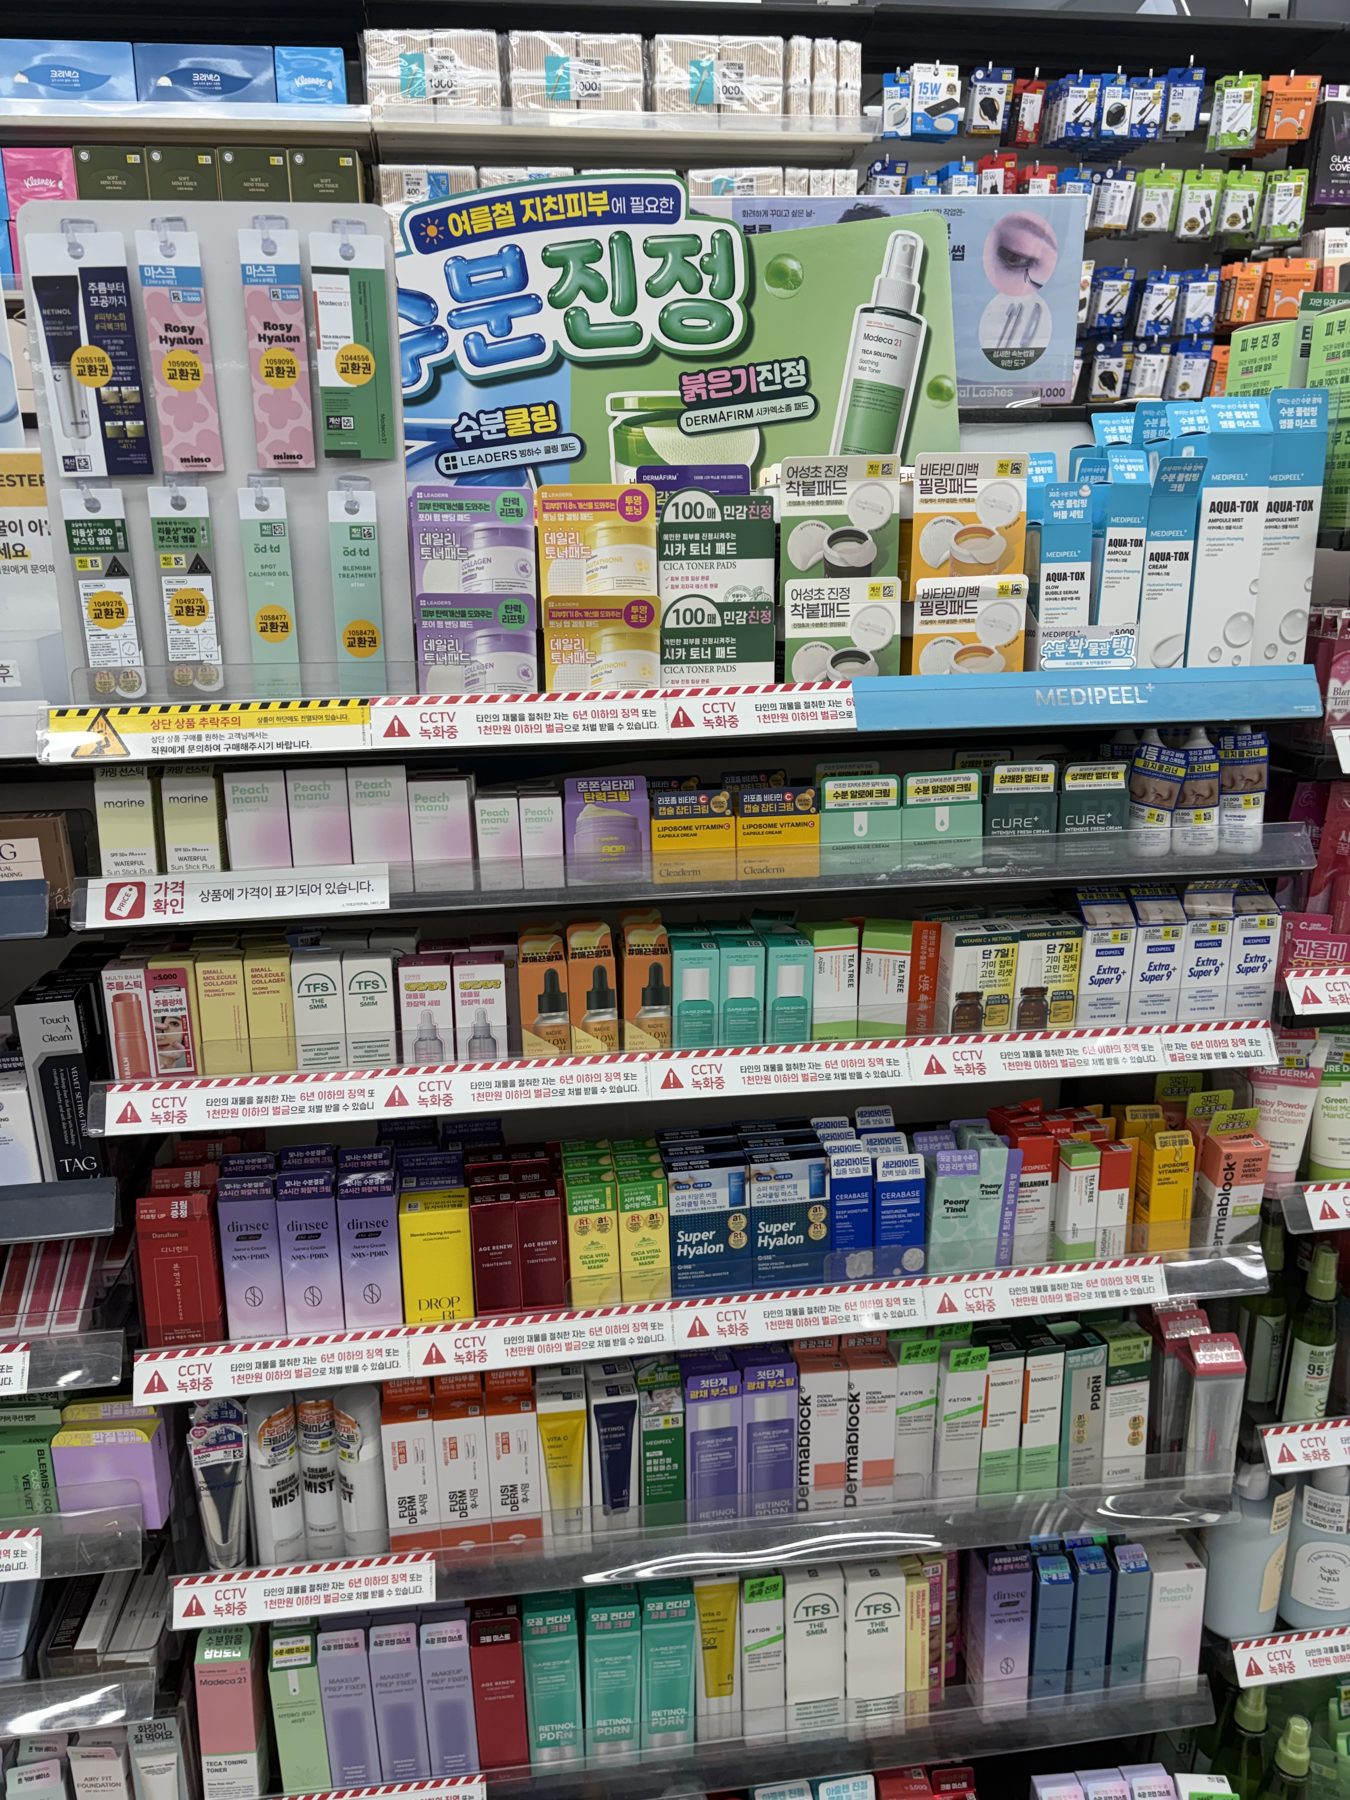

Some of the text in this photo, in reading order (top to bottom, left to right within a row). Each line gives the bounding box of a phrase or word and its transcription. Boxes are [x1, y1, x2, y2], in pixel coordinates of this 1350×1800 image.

[50, 70, 79, 78] 크리넥스
[918, 82, 941, 95] 15W
[447, 199, 515, 238] 여름철
[629, 196, 674, 216] 필요한
[742, 204, 804, 218] 화려하게 꾸미고 싶은
[144, 266, 176, 279] 마스크
[88, 282, 125, 294] 주름부터
[90, 295, 127, 307] 모공까지
[42, 308, 72, 316] RETINOL
[164, 323, 195, 335] Rosy
[159, 335, 203, 346] Hyalon
[863, 333, 902, 347] Madeca 21
[862, 348, 897, 360] TECA SOLUTION
[859, 357, 879, 367] Soothing
[1000, 359, 1026, 367] 위한 도구
[76, 363, 109, 377] 교환권
[167, 368, 200, 381] 교환권
[339, 362, 371, 375] 교환권
[681, 359, 806, 402] 붉은기진정
[685, 400, 810, 429] DERMAFIRM 시카엑소좀 패드
[454, 401, 557, 442] 수분쿨링
[180, 456, 211, 464] mimo
[460, 441, 577, 467] LEADERS 빙하수 쿨링 패드
[787, 464, 848, 479] 어성초 진정
[920, 463, 979, 477] 비타민 미백
[785, 479, 850, 497] 착붙패드
[919, 479, 978, 495] 필링패드
[502, 497, 520, 506] 탄력
[1209, 500, 1259, 513] AQUA-TOX
[1266, 500, 1314, 512] AQUA-TOX
[499, 508, 524, 518] 리프팅
[723, 503, 772, 520] 민감진정
[420, 531, 457, 546] 데일리
[420, 547, 470, 561] 토너패드
[663, 561, 736, 571] CICA TONER PADS
[420, 712, 456, 724] CCTV
[476, 708, 657, 722] 타인의 재물을 절취한 자는 6년 이하의 징역 또는
[151, 716, 241, 730] 상단 상품 추락주의
[477, 720, 659, 735] 1천만원 이하의 벌금으로 처벌 받을 수 있습니다.
[151, 731, 268, 743] 상단 상품 구매를 원하는 고객님께서는
[419, 724, 458, 740] 녹화중
[151, 740, 313, 754] 직원에게 문의하여 구매해주시기 바랍니다.
[355, 779, 392, 791] Peach
[356, 790, 390, 798] manu
[582, 790, 630, 802] 탄력크림
[832, 788, 890, 800] 수분 알로에 크림
[104, 798, 145, 809] marine
[657, 824, 693, 832] LIPOSOME
[743, 865, 785, 875] Cleaderm
[153, 880, 185, 896] 가격
[199, 880, 374, 902] 상품에 가격이 표기되어 있습니다.
[153, 899, 185, 914] 확인
[1243, 953, 1266, 963] Extra
[1236, 963, 1260, 974] Super
[305, 982, 329, 993] TFS
[40, 1015, 70, 1025] Touch
[64, 1025, 72, 1033] A
[42, 1033, 73, 1043] Gleam
[1256, 1098, 1308, 1109] Baby Powder
[60, 1157, 97, 1173] TAG
[882, 1157, 919, 1168] 세라마이드
[881, 1190, 920, 1199] CERABASE
[944, 1199, 969, 1208] Peony
[945, 1205, 967, 1213] Tinol
[677, 1230, 715, 1243] Super
[677, 1243, 724, 1258] Hyalon
[419, 1296, 460, 1311] DROP
[716, 1310, 747, 1322] CCTV
[716, 1324, 750, 1337] 녹화중
[757, 1369, 784, 1379] 첫단계
[1307, 1364, 1324, 1376] 95
[768, 1378, 794, 1389] 부스팅
[1091, 1375, 1101, 1410] PDRN
[304, 1480, 335, 1493] MIST
[501, 1484, 510, 1506] FUSI
[510, 1483, 519, 1511] DERM
[802, 1605, 831, 1617] TFS
[1267, 1650, 1292, 1662] CCTV
[1269, 1663, 1296, 1676] 녹화중
[200, 1676, 247, 1686] Madeca 21
[651, 1708, 688, 1718] RETINOL
[138, 1723, 166, 1733] 화장이
[651, 1716, 685, 1728] PDRN
[134, 1730, 174, 1744] 잘 먹어요
[77, 1781, 121, 1789] FOUNDATION
